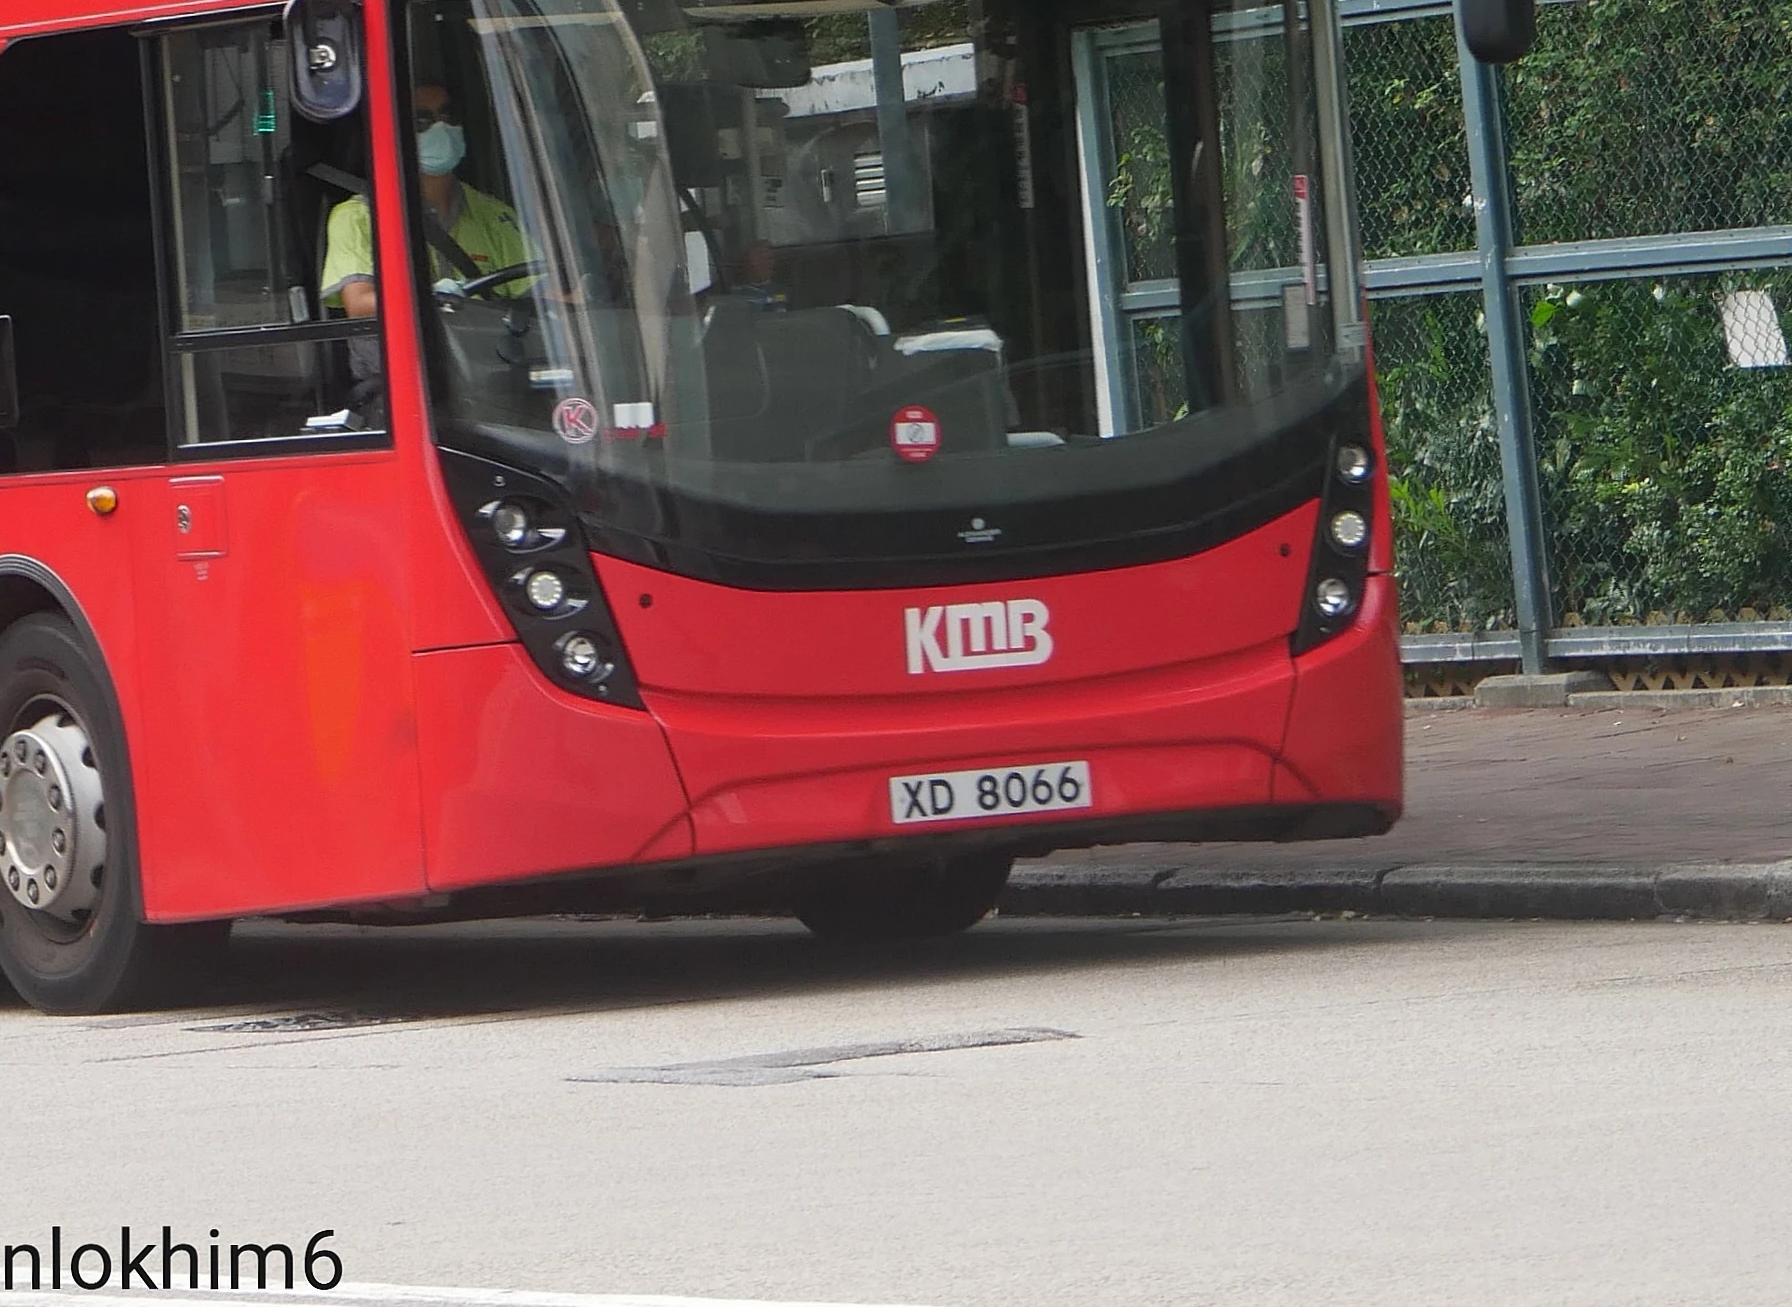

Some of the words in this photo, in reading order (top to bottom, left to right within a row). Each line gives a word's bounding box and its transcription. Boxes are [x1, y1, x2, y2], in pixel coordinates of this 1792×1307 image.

[903, 598, 1054, 674] KMB
[902, 777, 955, 819] XD
[976, 766, 1081, 811] 8066
